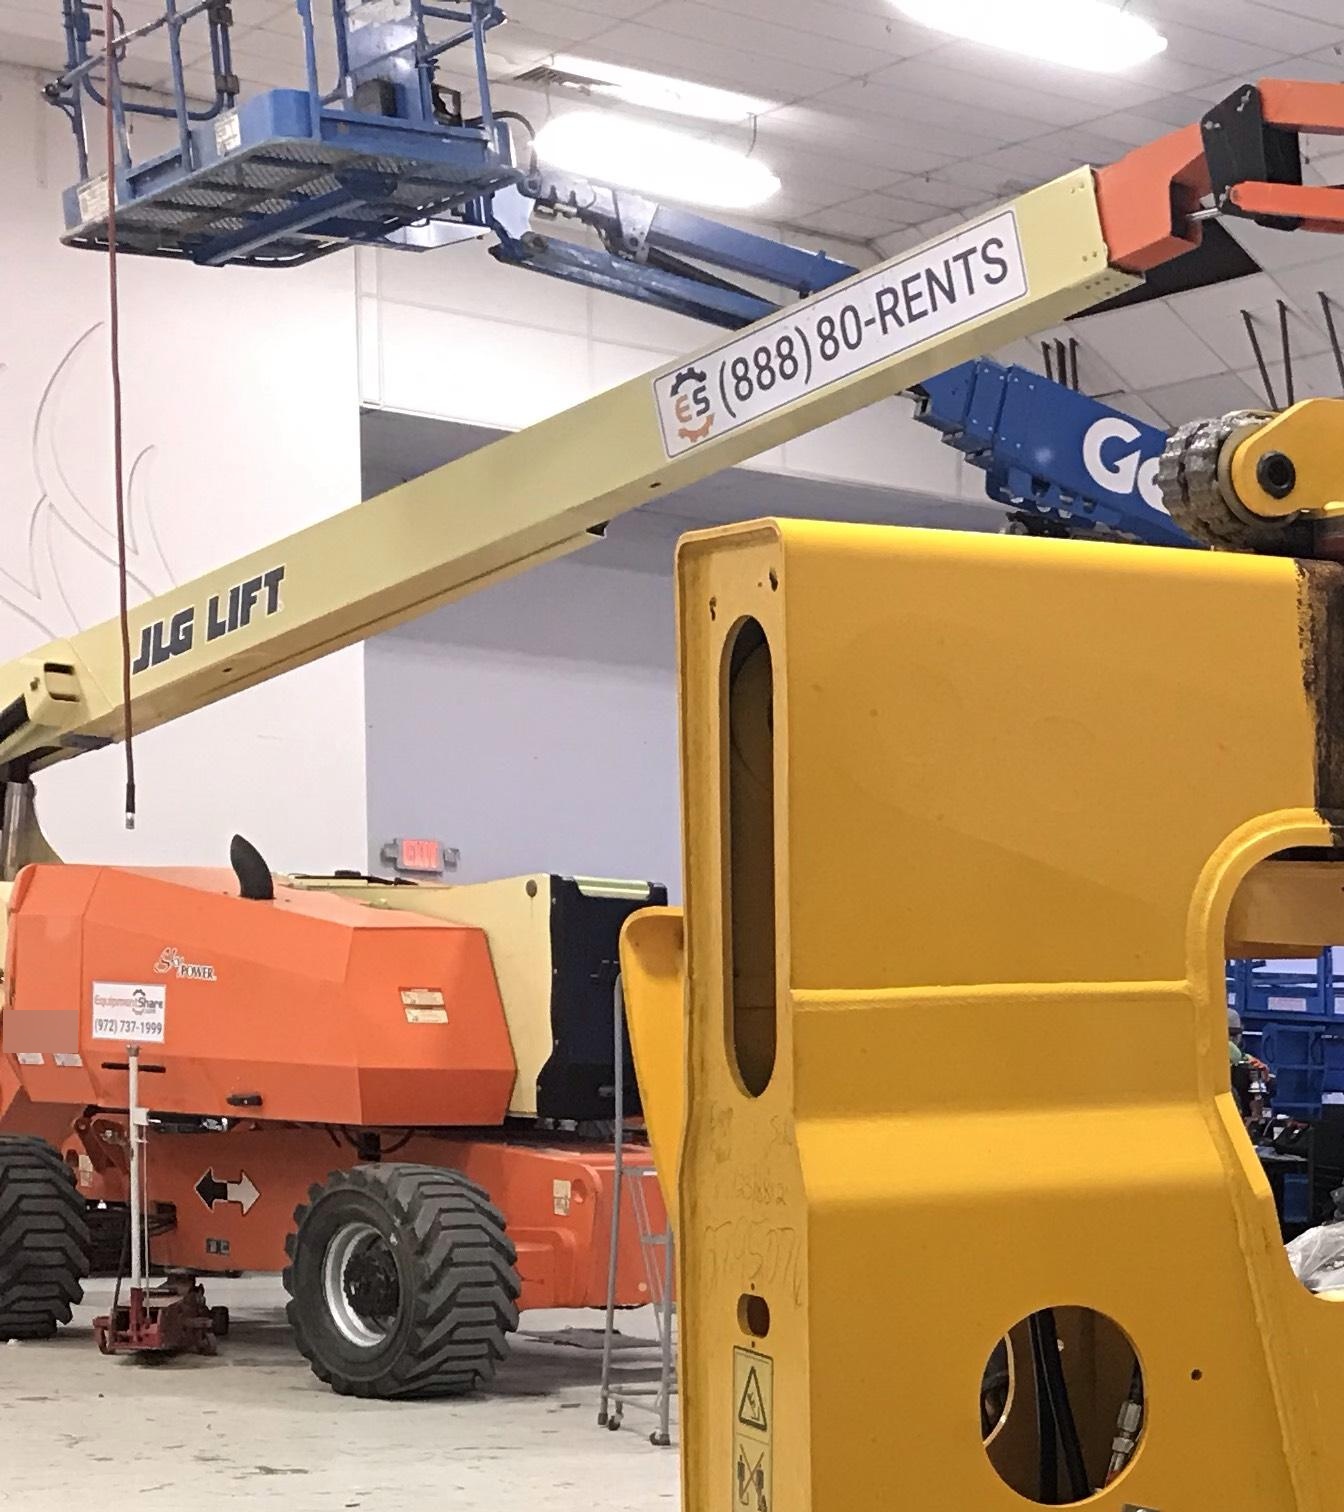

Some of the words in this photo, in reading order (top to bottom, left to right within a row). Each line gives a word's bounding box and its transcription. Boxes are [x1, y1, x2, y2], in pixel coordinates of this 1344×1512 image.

[719, 335, 812, 418] (888)
[815, 236, 1008, 361] 80-RENTS
[131, 605, 195, 676] JLG
[206, 564, 286, 643] LIFT
[94, 1018, 118, 1034] (972)
[119, 1020, 162, 1034] 737-1999
